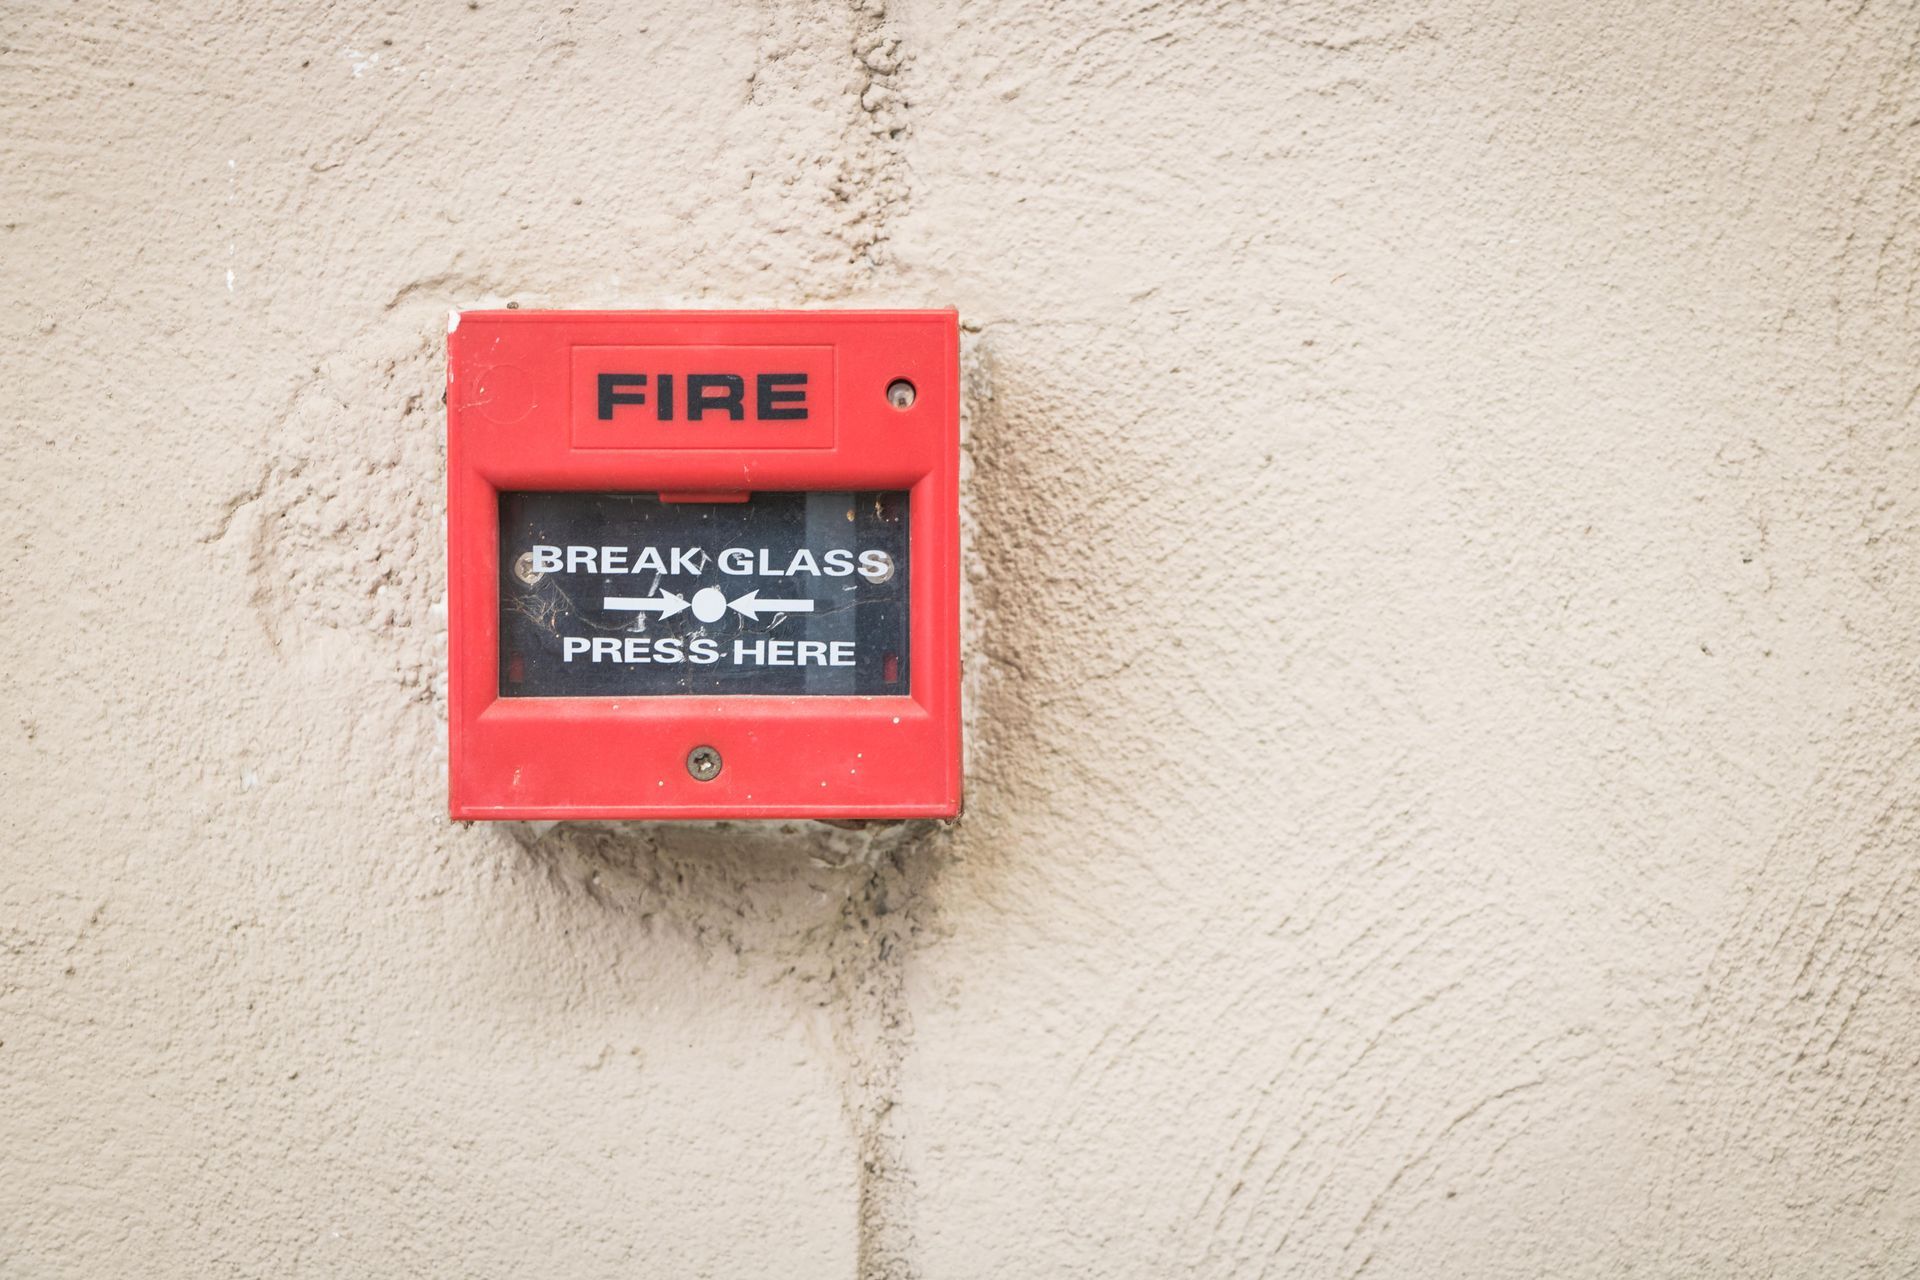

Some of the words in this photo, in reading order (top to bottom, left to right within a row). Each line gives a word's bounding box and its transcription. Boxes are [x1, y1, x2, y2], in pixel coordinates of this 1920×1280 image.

[597, 373, 809, 421] FIRE
[531, 545, 702, 576] BREAK
[718, 547, 890, 577] GLASS
[563, 636, 720, 665] PRESS
[733, 640, 857, 667] HERE
